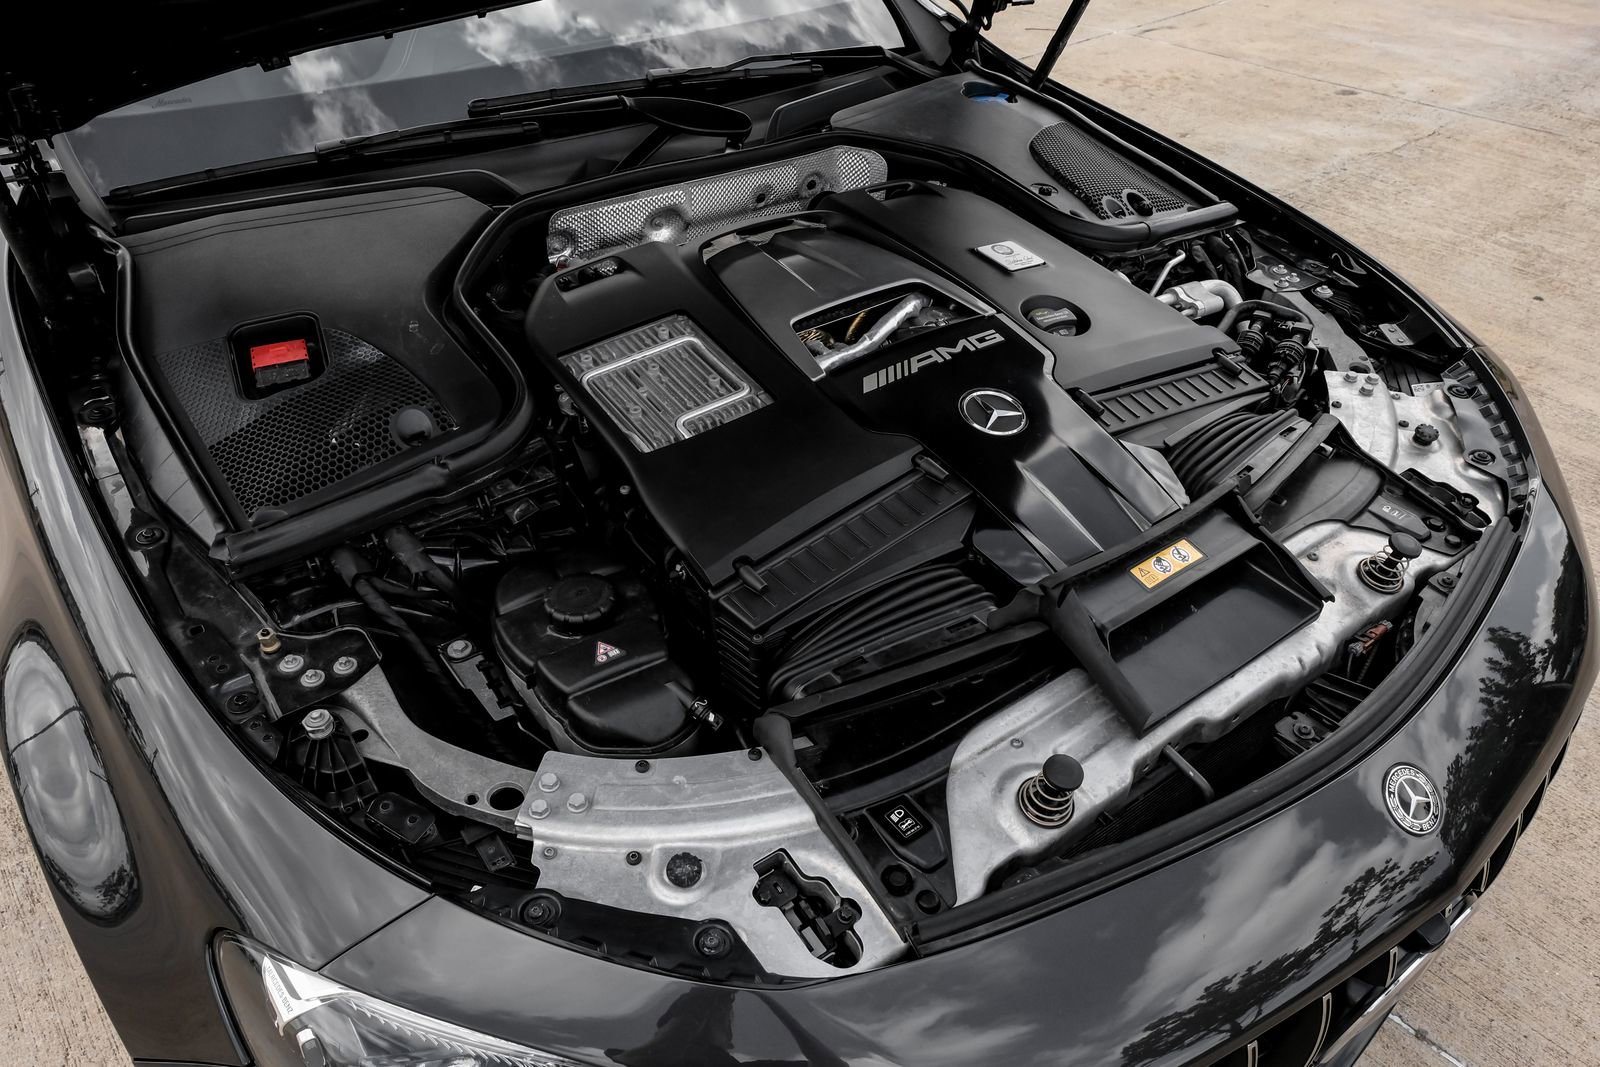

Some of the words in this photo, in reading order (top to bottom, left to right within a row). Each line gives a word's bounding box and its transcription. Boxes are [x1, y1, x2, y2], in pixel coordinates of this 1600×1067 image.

[909, 329, 1005, 374] AMG
[1389, 768, 1415, 793] MERCEDES
[1422, 815, 1437, 831] BENZ
